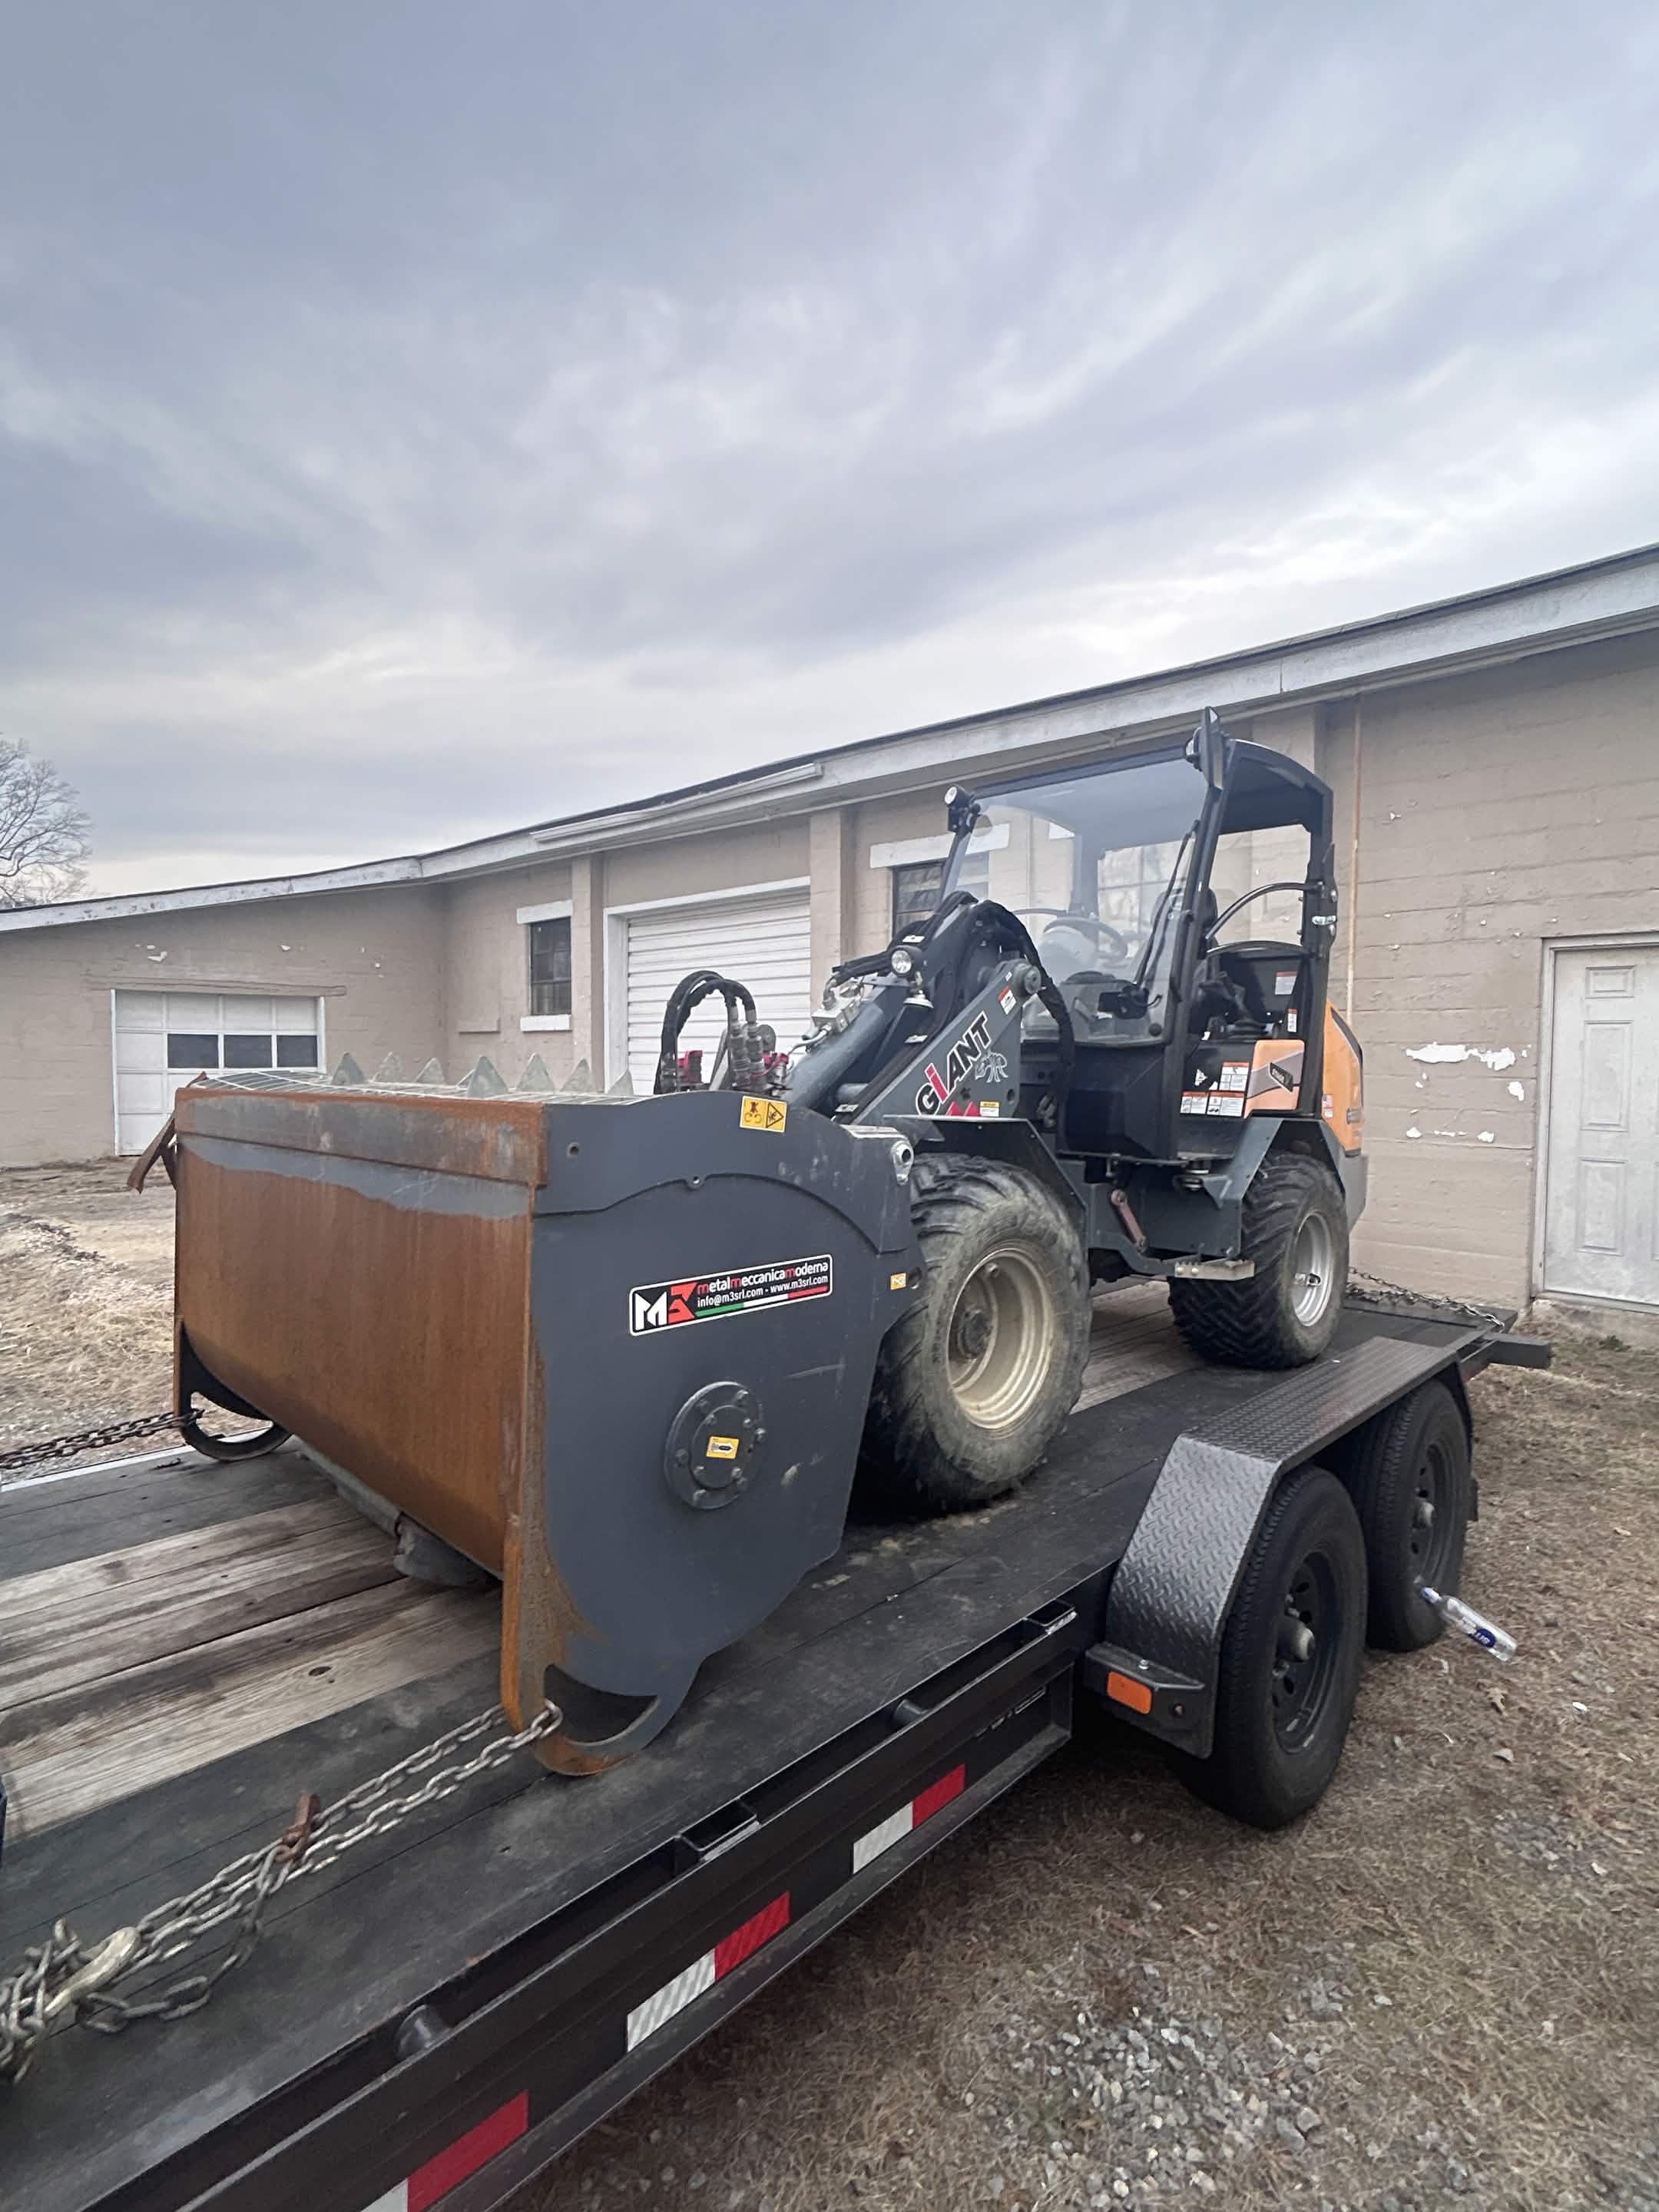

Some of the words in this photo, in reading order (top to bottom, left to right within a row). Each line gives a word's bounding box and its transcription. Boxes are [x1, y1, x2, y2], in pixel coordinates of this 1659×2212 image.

[697, 1262, 828, 1295] metalmeccanicamoderna
[697, 1287, 763, 1308] info@m3srl.com
[770, 1274, 828, 1293] www.m3srl.com
